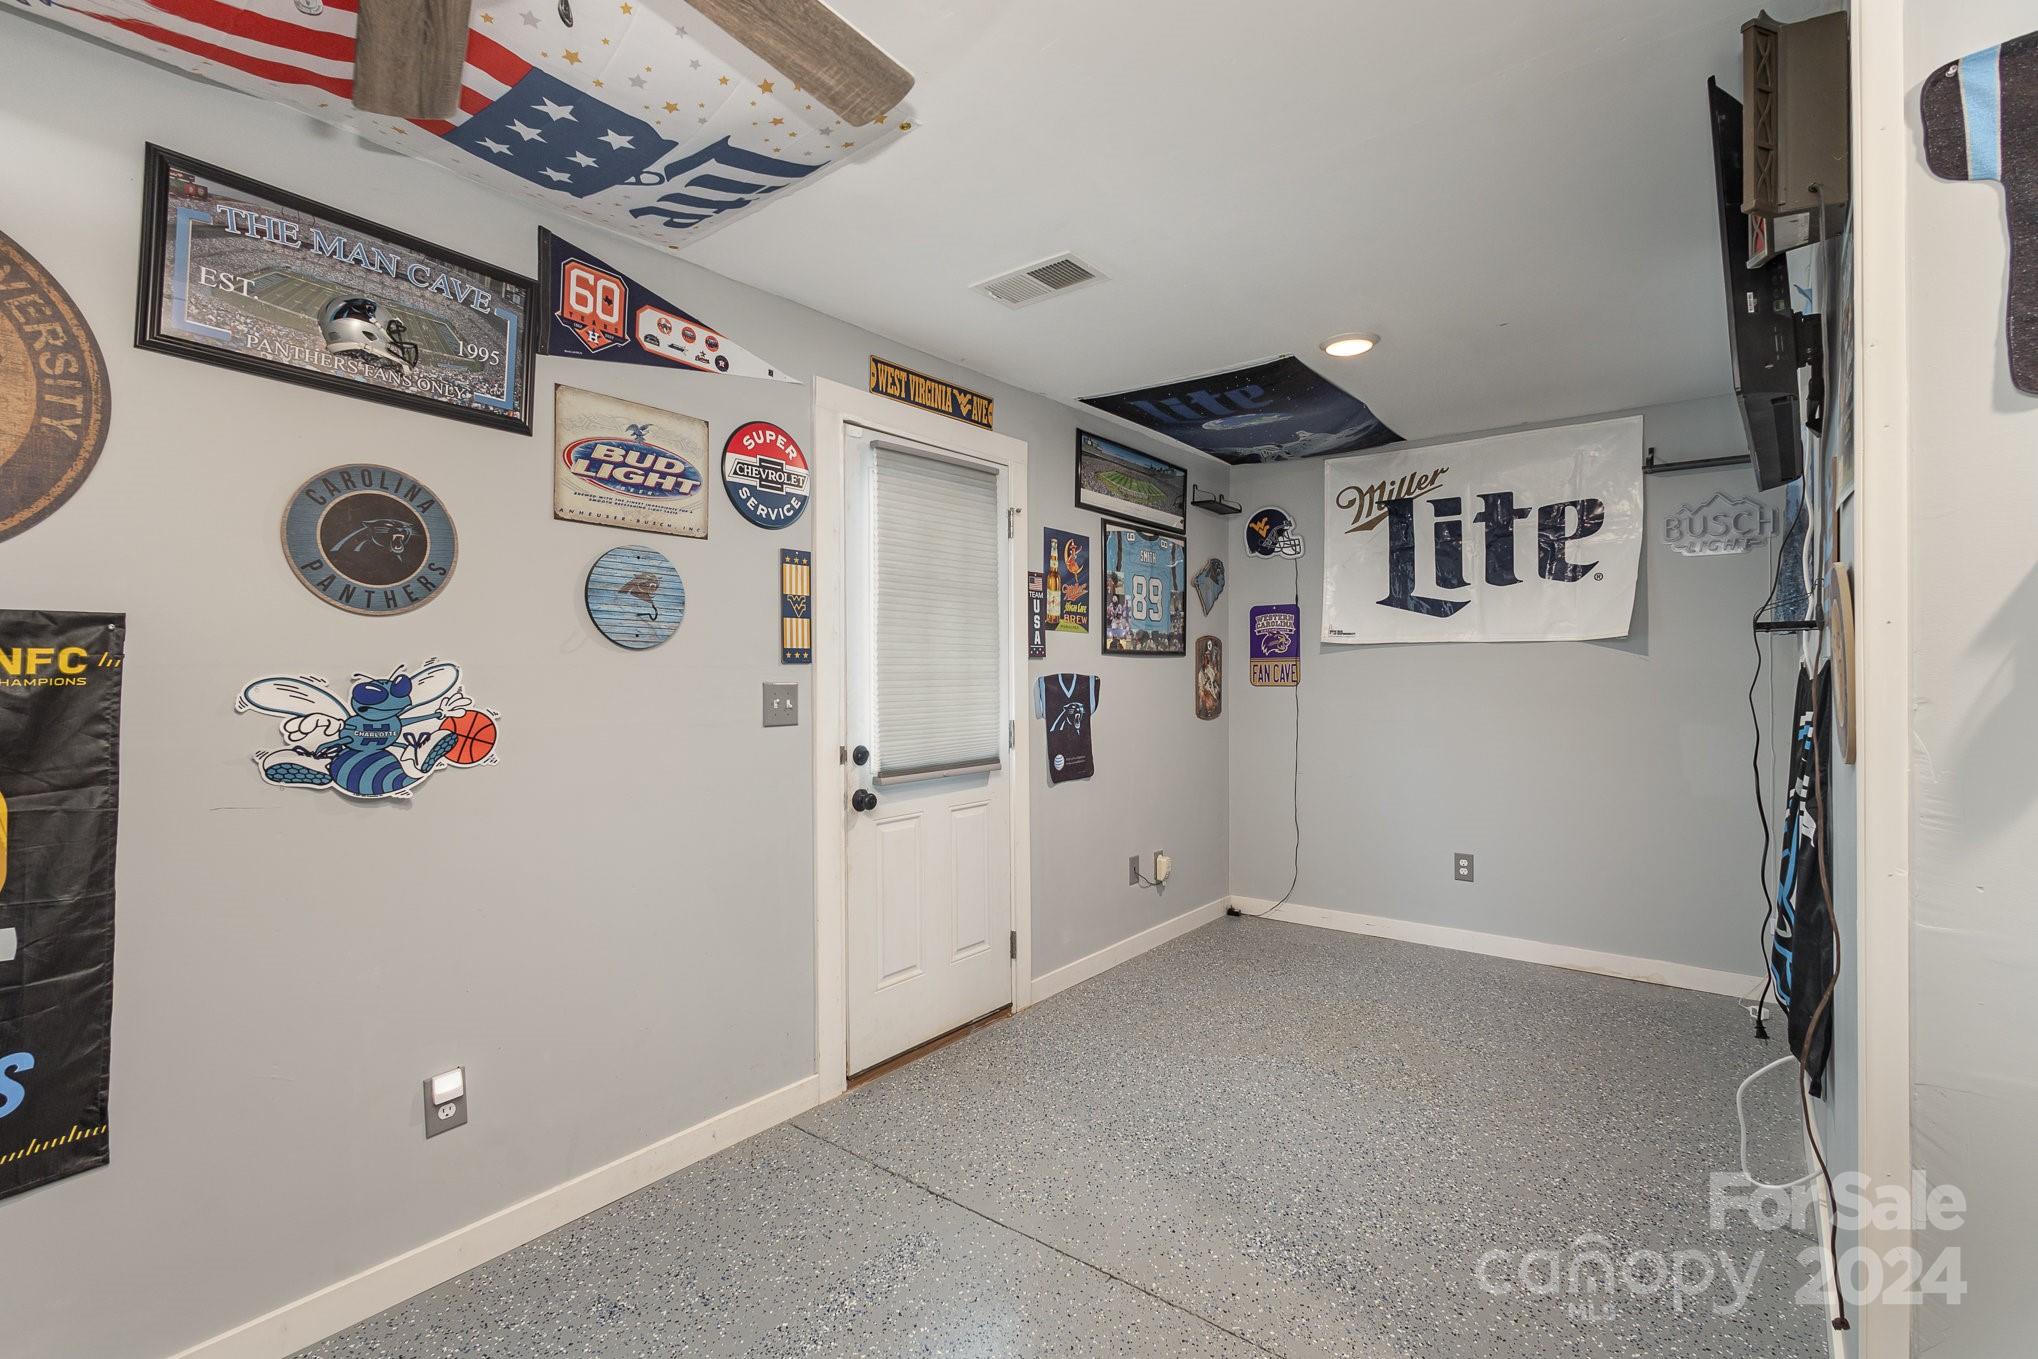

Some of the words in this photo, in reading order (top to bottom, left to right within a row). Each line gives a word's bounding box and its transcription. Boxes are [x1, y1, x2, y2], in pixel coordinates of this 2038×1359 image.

[216, 204, 301, 249] THE
[310, 227, 400, 278] MAN
[407, 263, 492, 314] CAVE
[199, 266, 258, 300] EST.
[569, 268, 620, 323] 60
[246, 334, 359, 374] PANTHERS
[364, 363, 412, 387] FANS
[457, 341, 500, 366] 1995
[878, 363, 907, 398] WEST
[909, 374, 953, 412] VIRGINIA
[591, 443, 685, 474] BUD
[742, 430, 798, 461] SUPER
[305, 468, 436, 514] CAROLINA
[571, 459, 701, 496] LIGHT
[736, 463, 804, 486] CHEVROLET
[738, 486, 801, 520] SERVICE
[1336, 466, 1449, 534] Miller
[1664, 508, 1780, 542] BUSCH
[1376, 491, 1606, 619] Lite
[300, 558, 447, 609] PANTHERS
[1029, 591, 1044, 599] TEAM
[1132, 574, 1163, 622] 89
[1063, 614, 1088, 624] BREW
[1252, 664, 1270, 683] FAN
[1273, 663, 1298, 683] CAVE
[354, 730, 397, 738] CHARLOTTE
